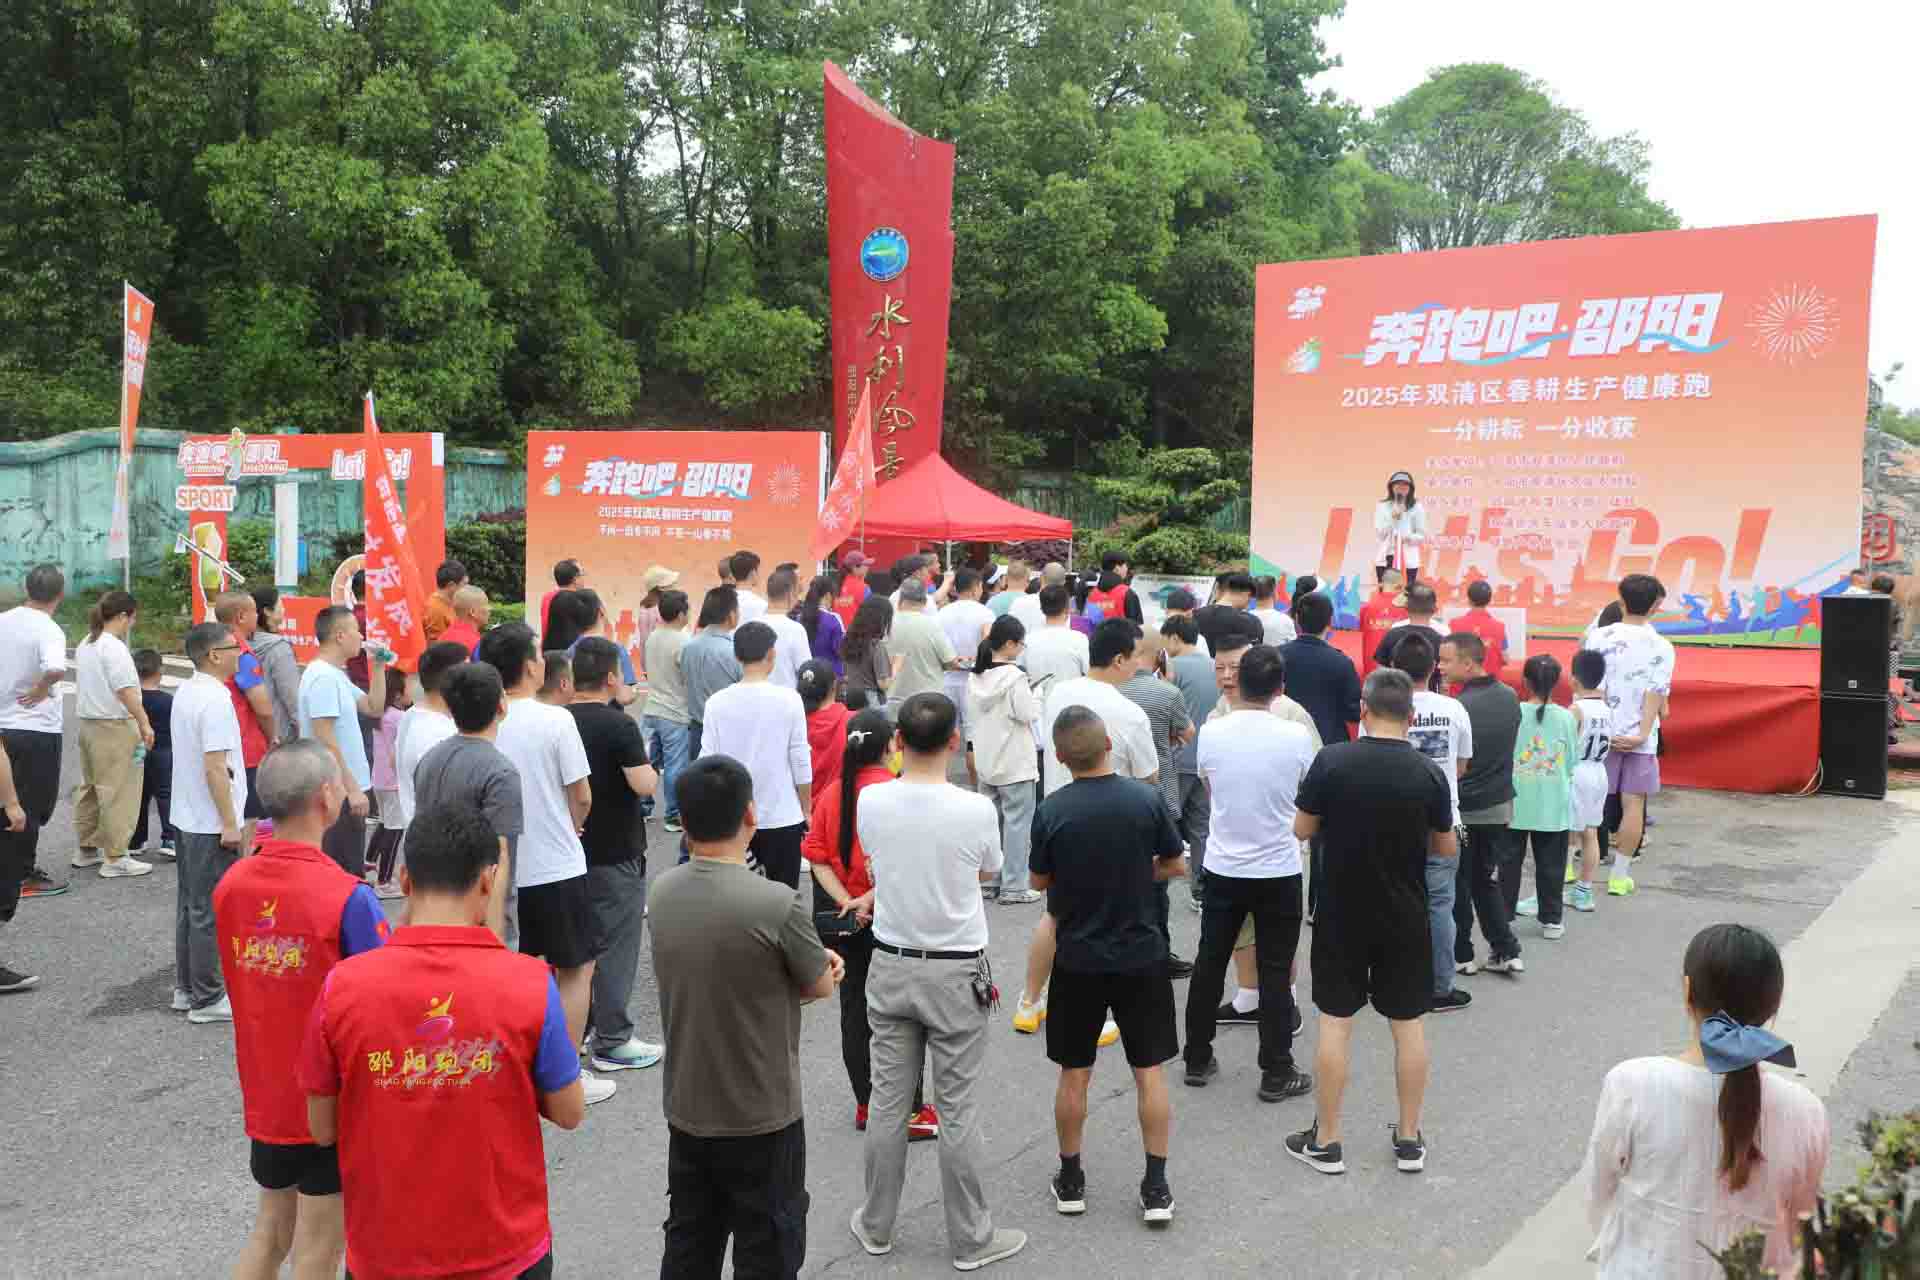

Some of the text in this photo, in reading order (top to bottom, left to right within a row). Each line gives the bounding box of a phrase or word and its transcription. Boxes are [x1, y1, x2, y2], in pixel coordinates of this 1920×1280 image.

[1342, 371, 1713, 409] 2025年双清区春耕生产健康跑
[1534, 415, 1638, 441] 一分收获
[178, 488, 233, 510] SPORT
